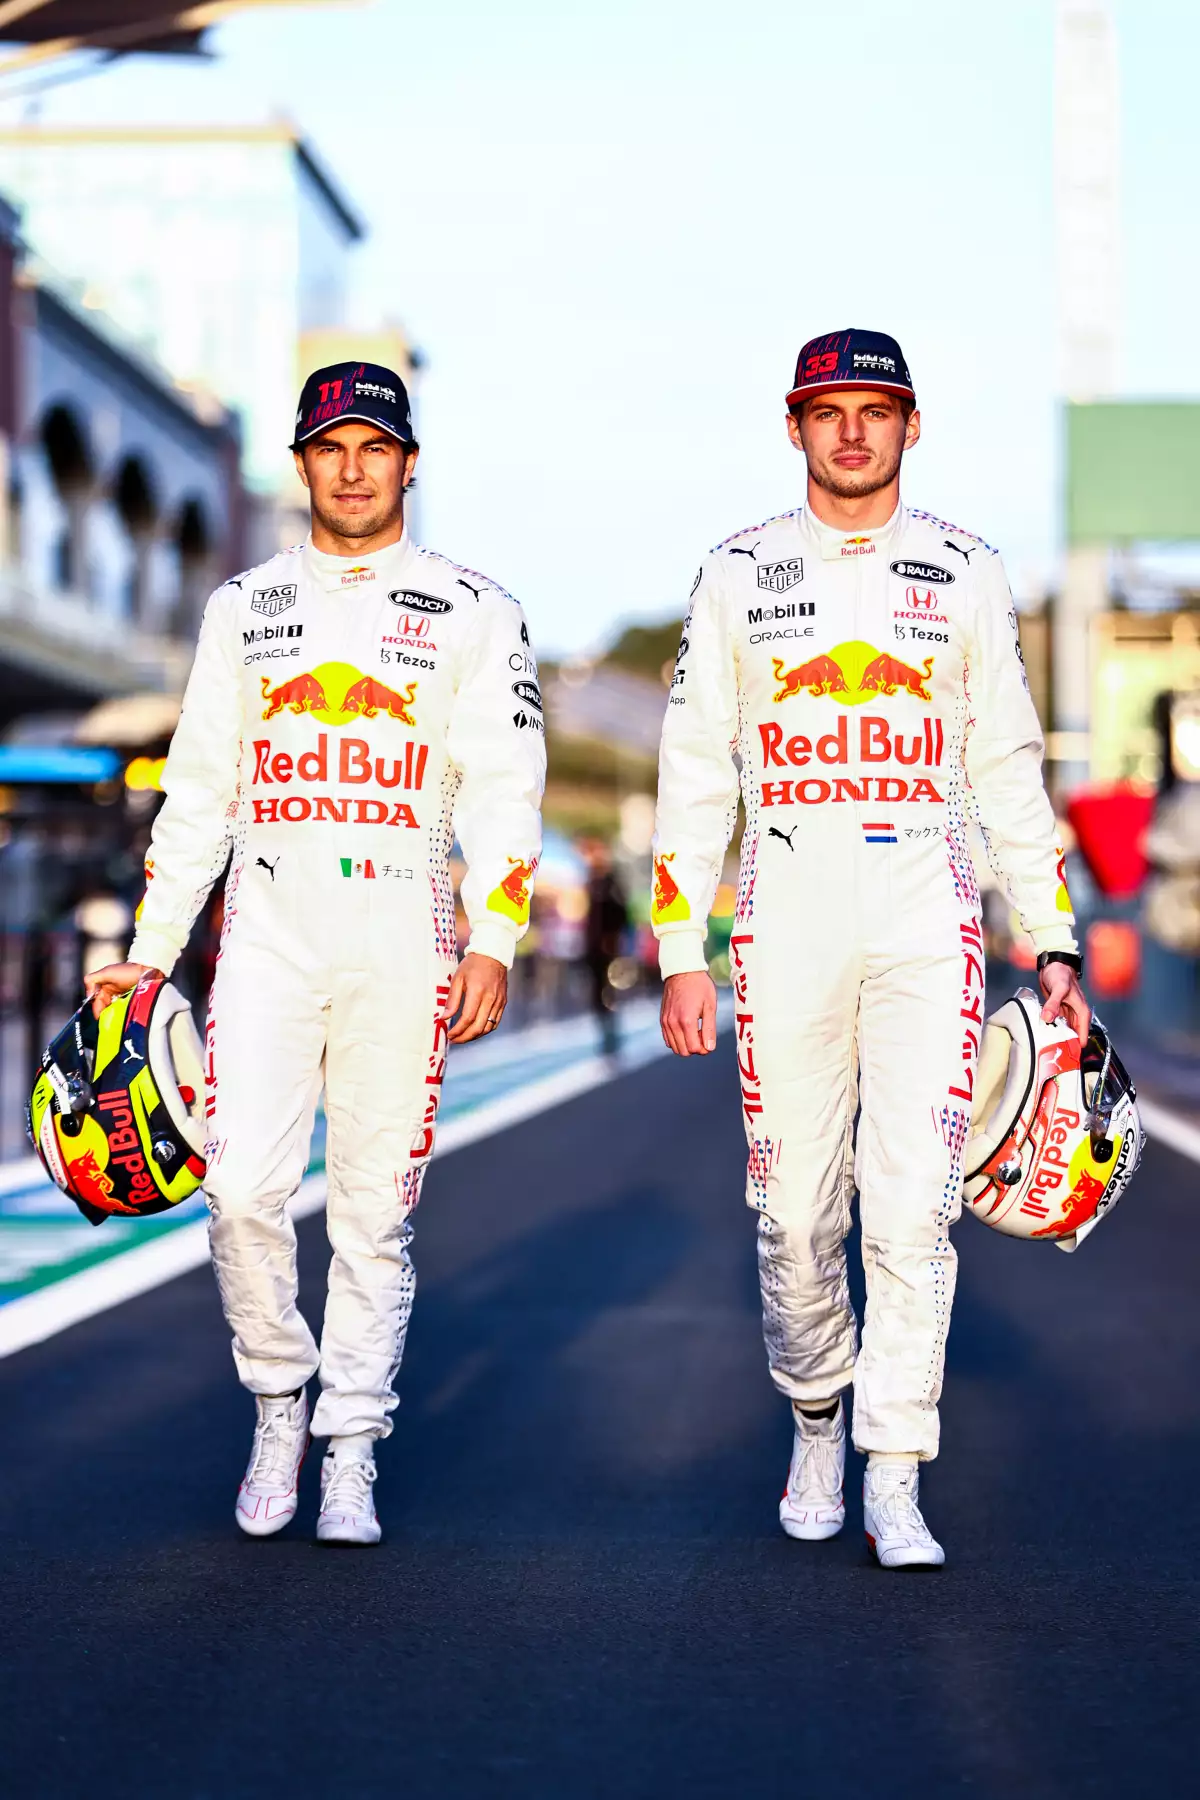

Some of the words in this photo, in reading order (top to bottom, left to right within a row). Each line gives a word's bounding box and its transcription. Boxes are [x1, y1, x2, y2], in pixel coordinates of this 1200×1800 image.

[805, 351, 839, 378] 33
[318, 379, 343, 403] 11
[841, 546, 858, 556] Red
[859, 545, 876, 555] Bull
[761, 560, 799, 576] TAG
[906, 564, 948, 582] RAUCH
[341, 575, 358, 585] Red
[359, 572, 376, 582] Bull
[760, 573, 800, 591] HEUER
[258, 587, 292, 601] TAG
[404, 594, 447, 612] RAUCH
[254, 598, 292, 615] HEUER
[747, 604, 796, 624] Mobil
[893, 611, 949, 624] HONDA
[242, 626, 285, 646] Mobil
[381, 635, 438, 651] HONDA
[749, 627, 814, 645] ORACLE
[909, 627, 949, 644] Tezos
[243, 647, 300, 666] ORACLE
[395, 651, 436, 670] Tezos
[758, 715, 848, 768] Red
[859, 716, 944, 766] Bull
[252, 733, 328, 785] Red
[338, 737, 429, 790] Bull
[760, 777, 945, 807] HONDA
[252, 796, 421, 829] HONDA
[903, 826, 943, 839] マックス
[97, 1088, 141, 1150] Bull
[1037, 1106, 1081, 1168] Red
[1098, 1128, 1135, 1208] CarNext
[112, 1153, 159, 1206] Red
[1019, 1169, 1064, 1220] Bull
